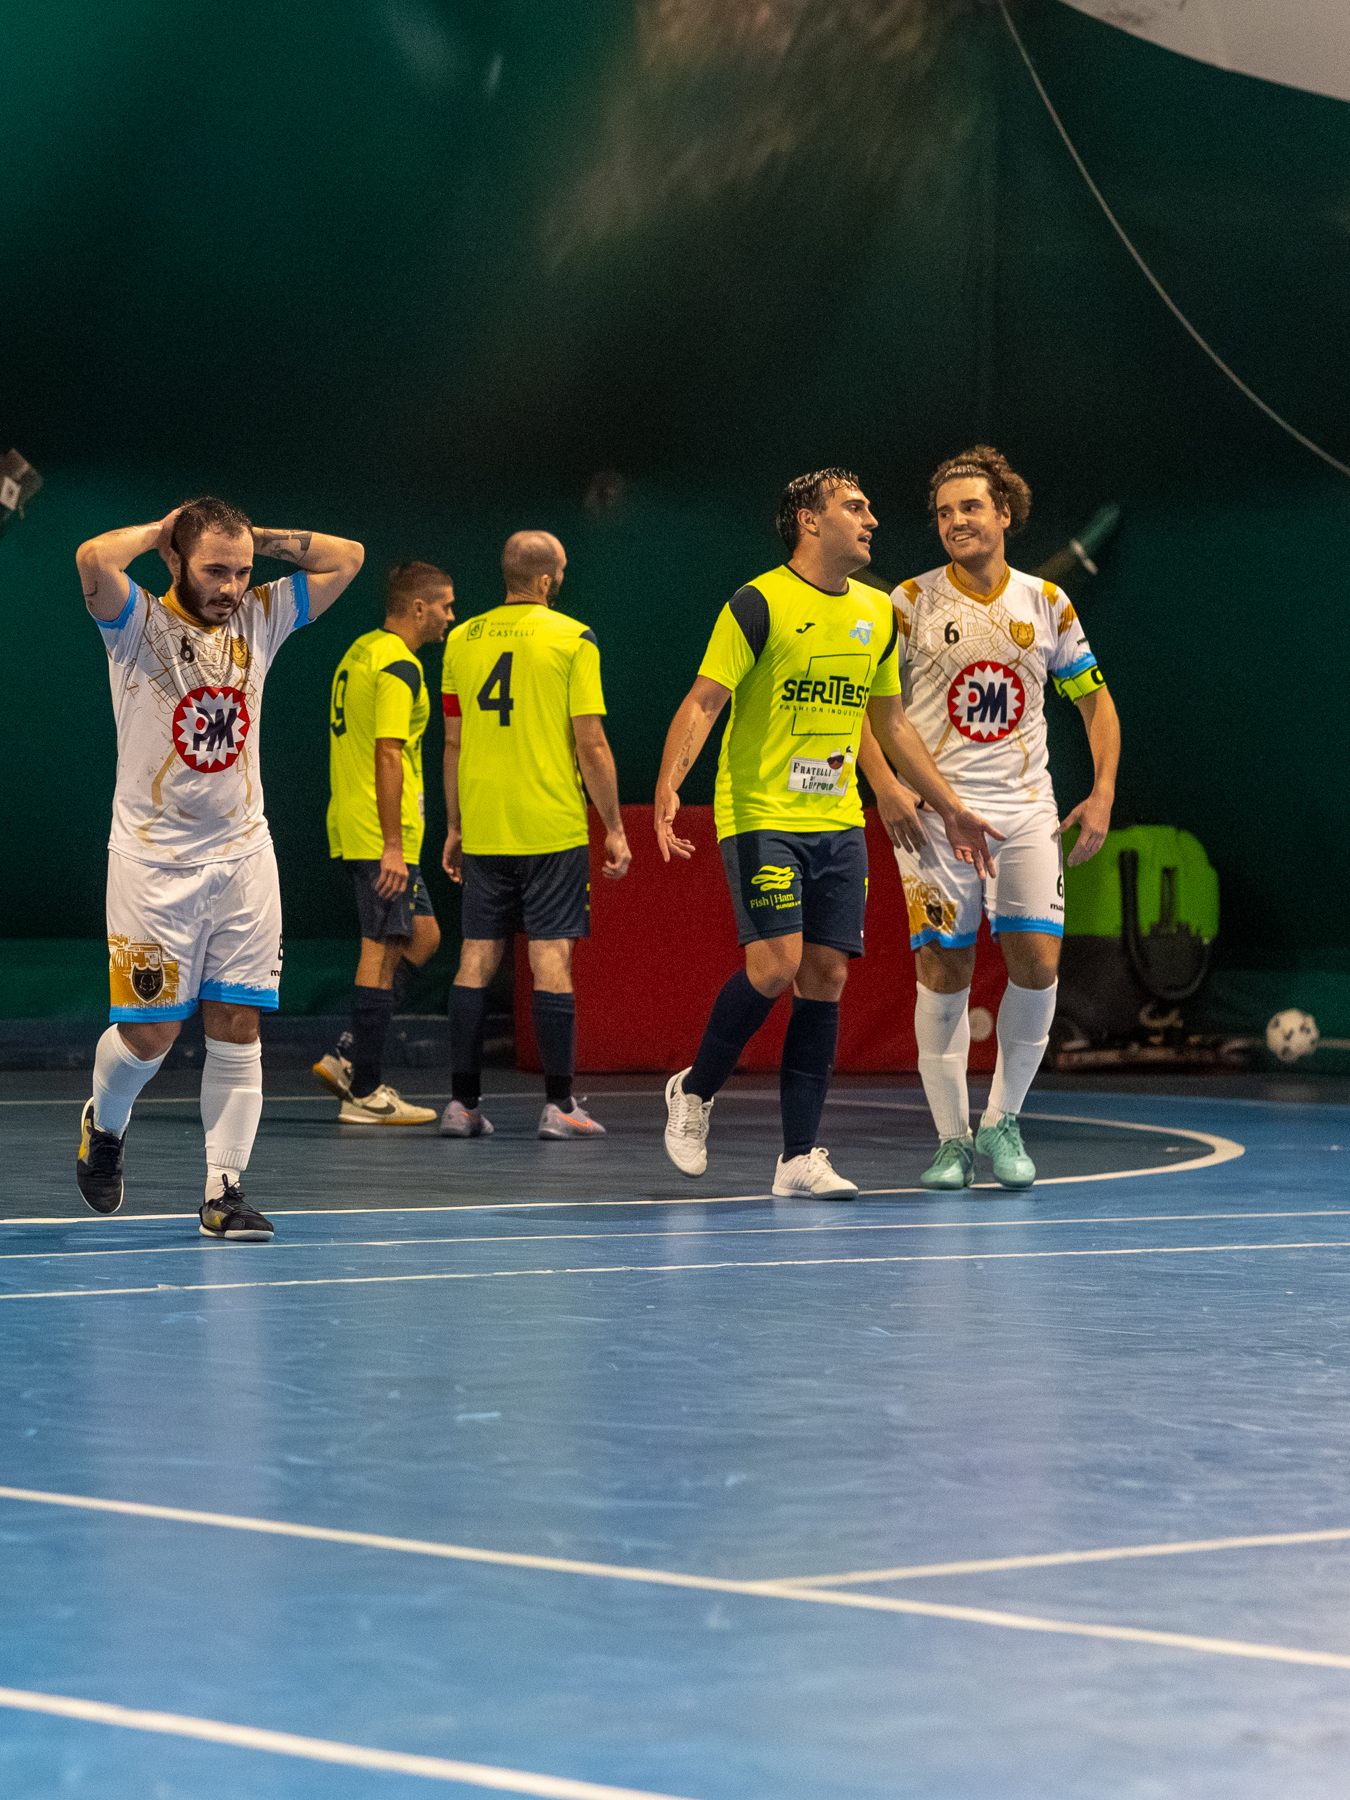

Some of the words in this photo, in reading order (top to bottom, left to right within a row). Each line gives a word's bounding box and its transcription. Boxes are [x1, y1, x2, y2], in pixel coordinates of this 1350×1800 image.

[488, 629, 535, 637] CASTELLI
[944, 621, 960, 645] 6
[476, 651, 514, 727] 4
[331, 669, 348, 738] 9
[779, 704, 824, 713] FASHION
[967, 681, 1008, 723] PM
[192, 706, 238, 752] PM
[793, 762, 832, 777] FRATELLI
[802, 778, 834, 791] LUPPOLO
[750, 896, 769, 908] Fish
[774, 893, 794, 903] Ham
